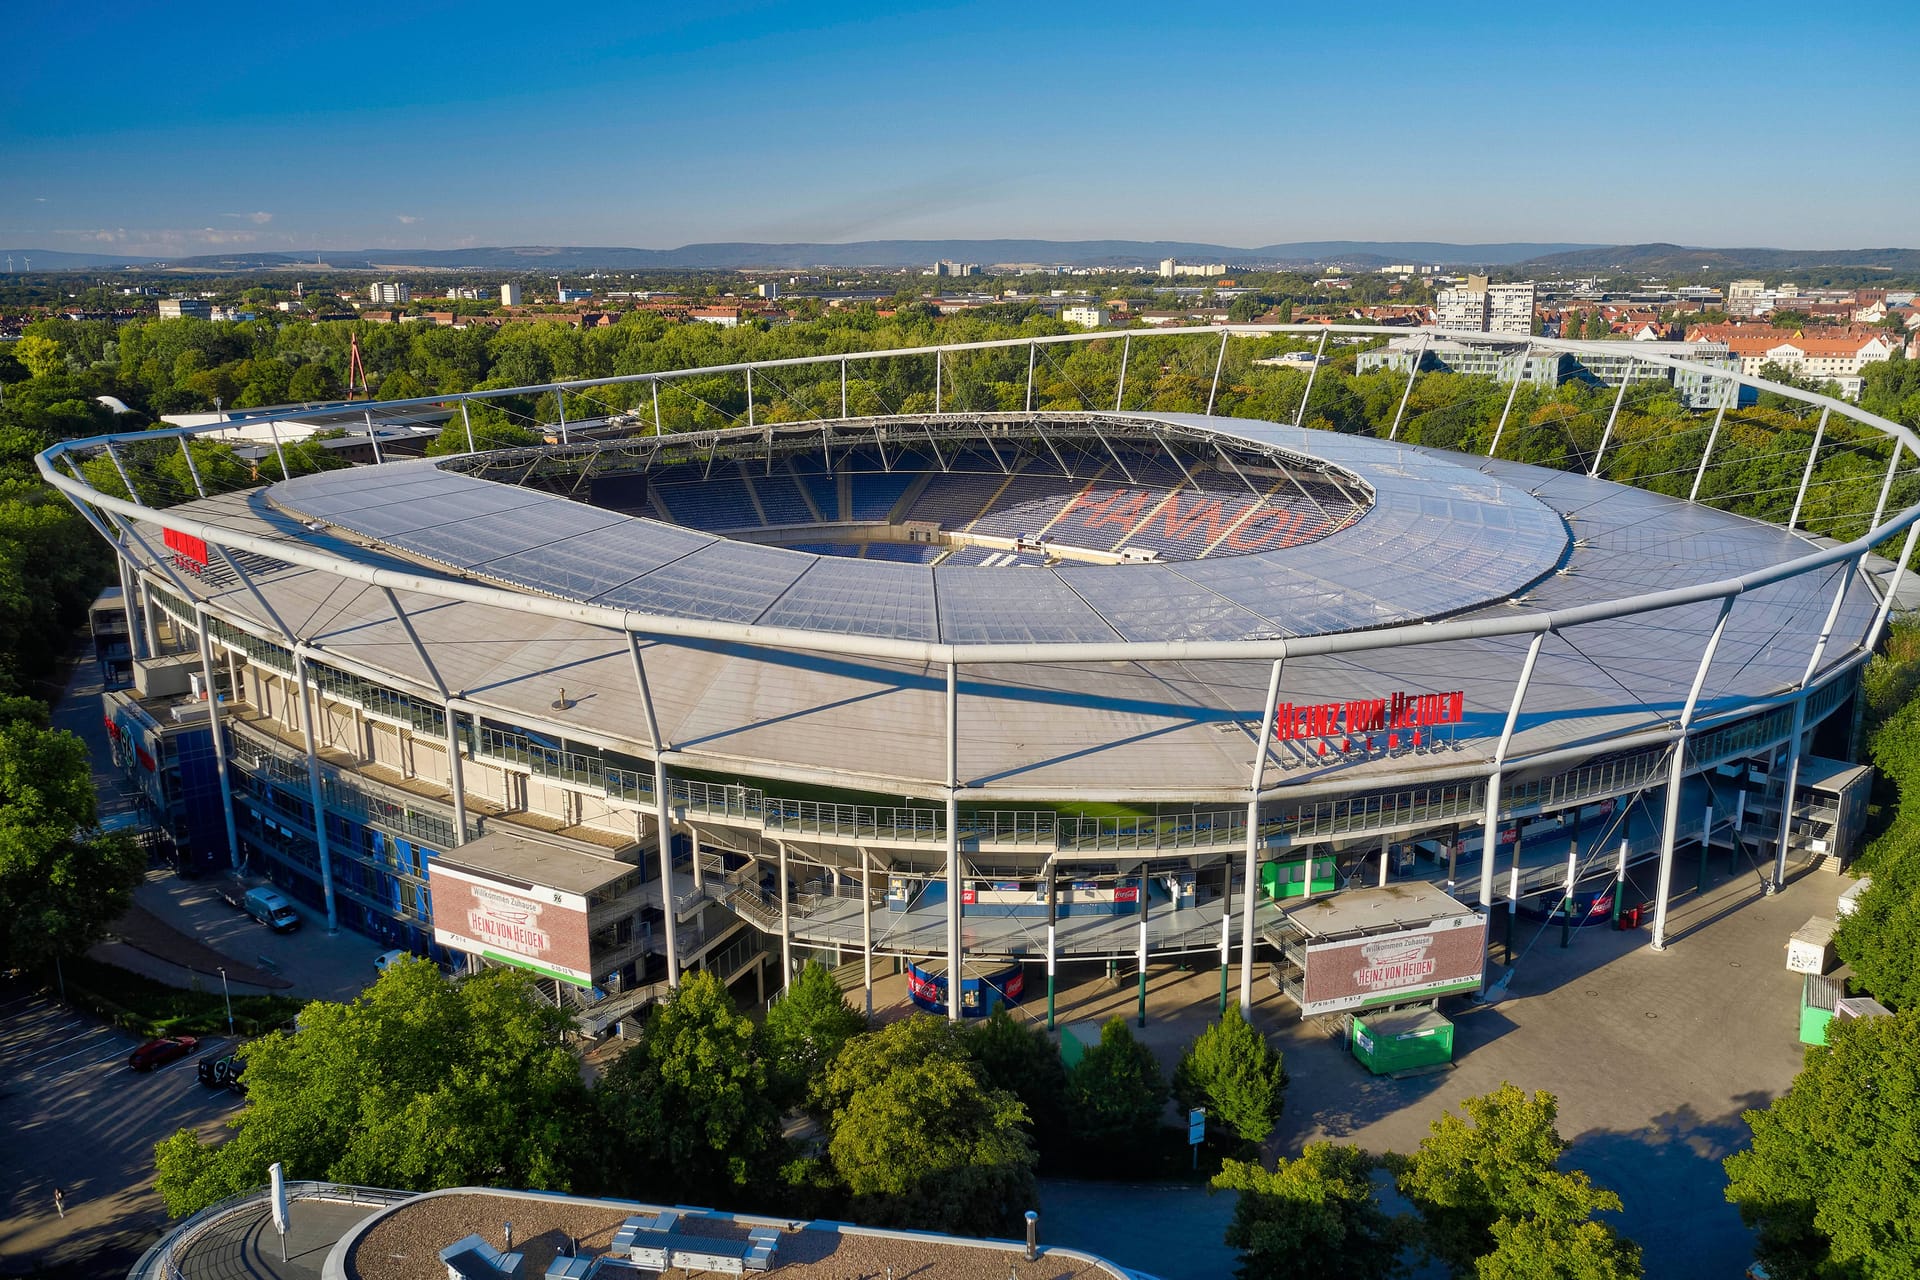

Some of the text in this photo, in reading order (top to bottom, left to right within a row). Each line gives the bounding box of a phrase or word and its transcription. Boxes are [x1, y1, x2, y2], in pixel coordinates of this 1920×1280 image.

[1277, 690, 1464, 741] HEINZ VON HEIDEN
[473, 887, 537, 912] Willkommen Zuhause
[553, 894, 562, 903] 96
[471, 912, 544, 949] HEINZ VON HEIDEN
[1365, 937, 1430, 953] Willkommen Zuhause
[1359, 960, 1433, 985] HEINZ VON HEIDEN
